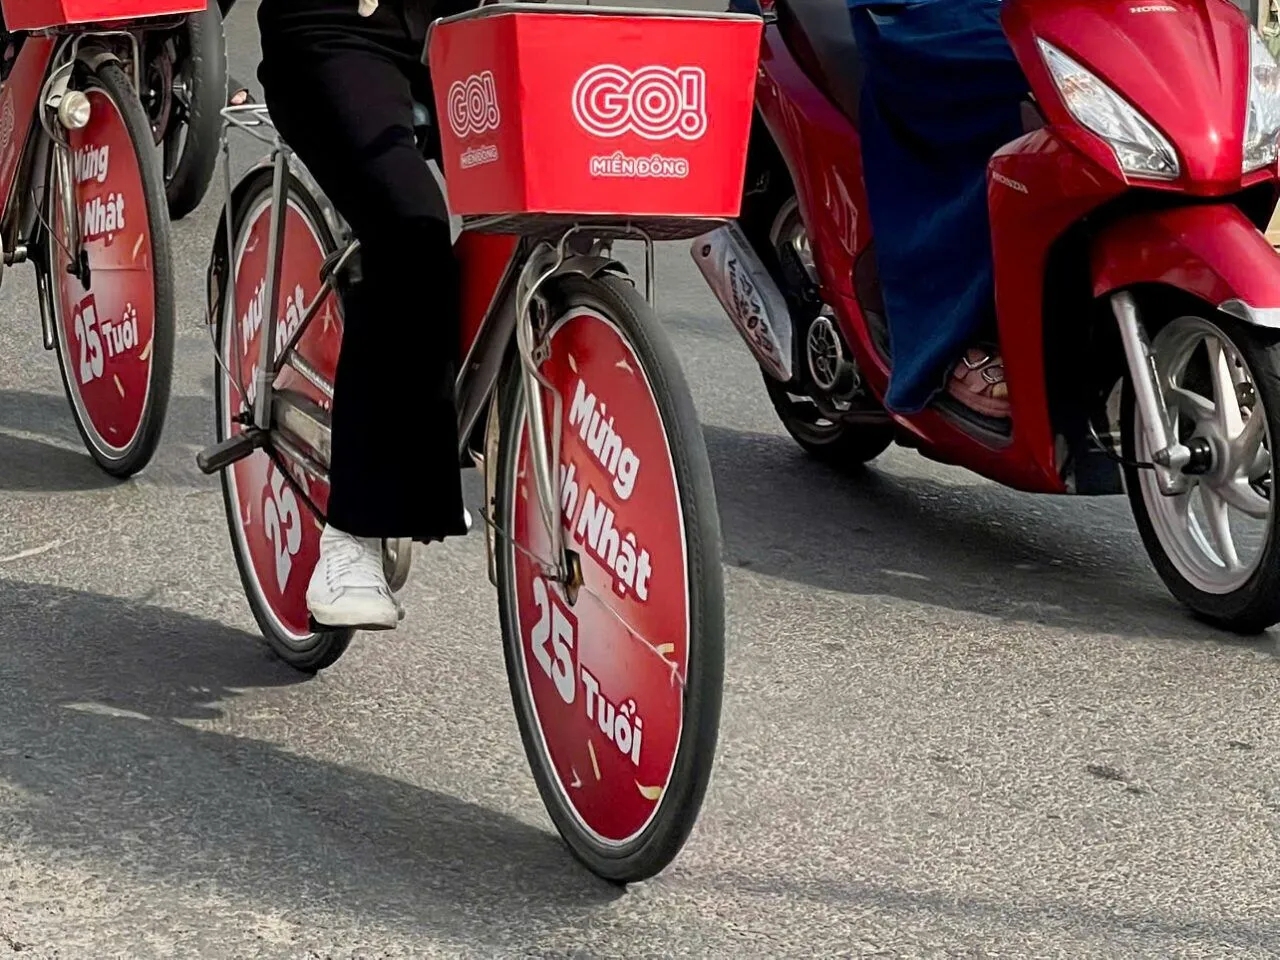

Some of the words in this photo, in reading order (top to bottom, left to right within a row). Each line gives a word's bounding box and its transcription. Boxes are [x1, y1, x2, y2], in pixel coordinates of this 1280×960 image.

[1129, 5, 1177, 14] HONDA
[448, 70, 500, 138] GO!
[571, 63, 708, 140] GO!
[590, 150, 635, 177] MIỀN
[636, 153, 689, 179] ĐÔNG
[992, 171, 1029, 195] HONDA
[84, 193, 126, 241] Nhật
[74, 303, 105, 385] 25
[101, 302, 138, 359] Tuổi
[568, 378, 640, 500] Mừng
[578, 488, 653, 602] Nhật
[531, 576, 576, 705] 25
[581, 671, 644, 767] Tuổi
